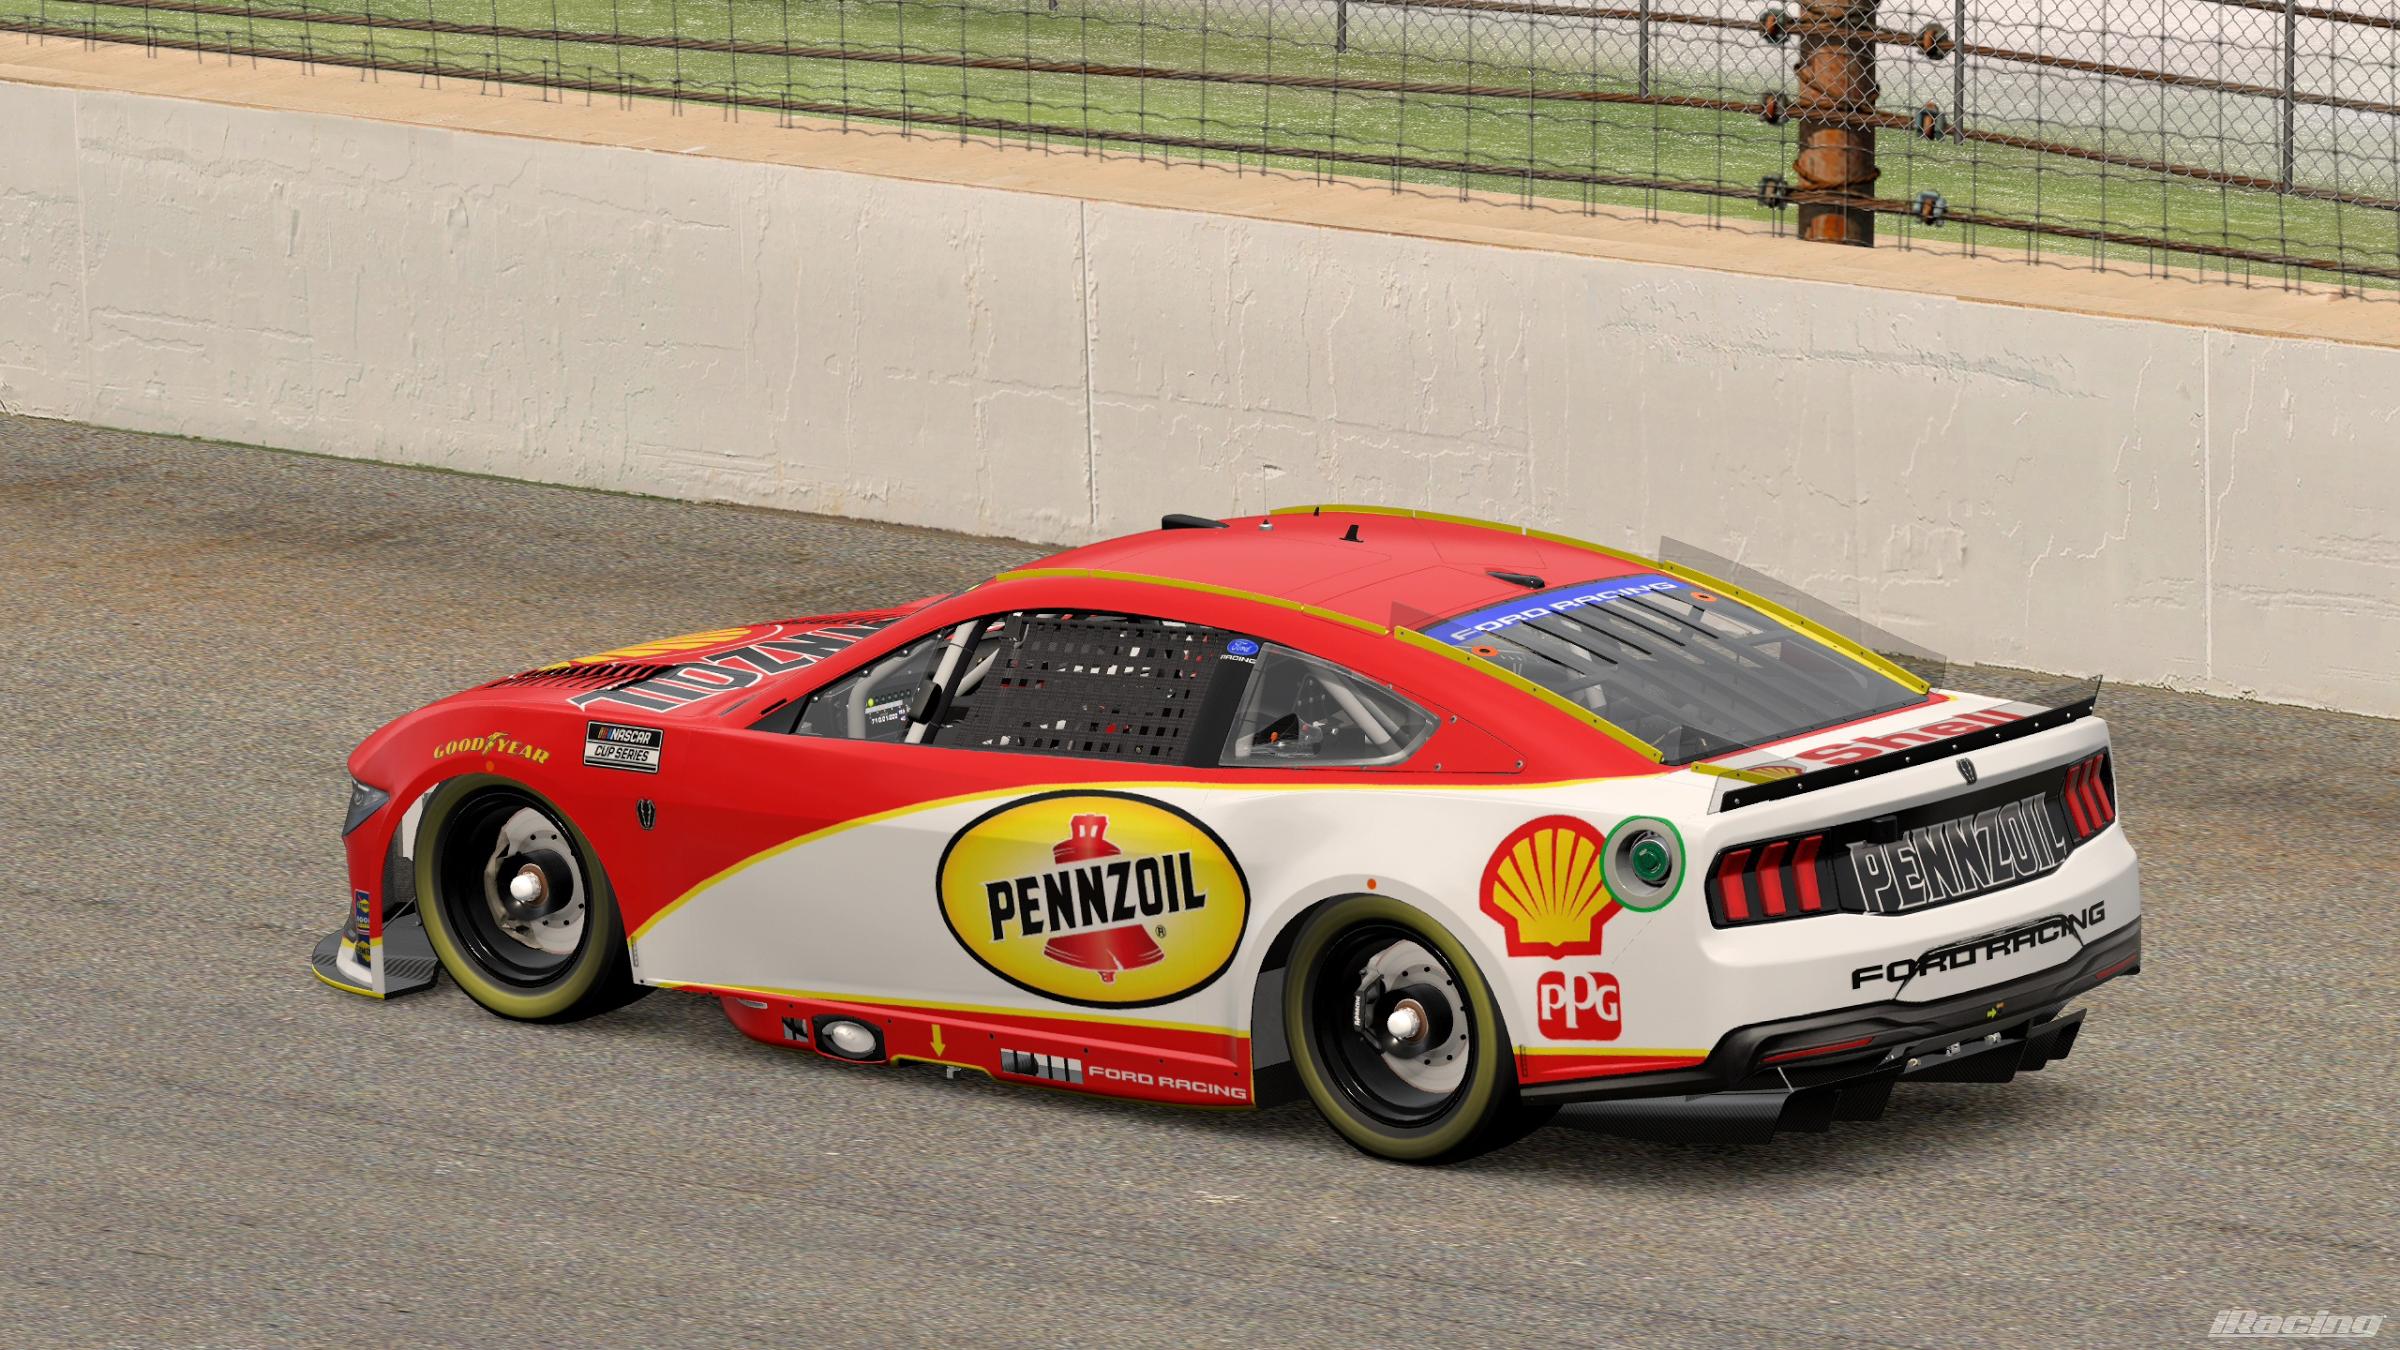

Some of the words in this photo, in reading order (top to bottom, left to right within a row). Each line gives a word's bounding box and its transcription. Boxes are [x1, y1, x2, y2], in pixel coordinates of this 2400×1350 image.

[1450, 607, 1551, 641] FORD
[1551, 581, 1679, 611] RACING
[433, 734, 550, 764] GOODYEAR
[594, 745, 616, 758] CUP
[615, 747, 649, 762] SERIES
[609, 728, 652, 745] NASCAR
[1794, 709, 2026, 766] Shell
[1846, 791, 2067, 915] PENNZOIL
[985, 851, 1207, 942] PENNZOIL
[1851, 947, 1977, 990] FORD
[1986, 900, 2106, 961] RACING
[1540, 970, 1619, 1029] PPG
[1088, 1065, 1154, 1086] FORD
[1158, 1076, 1247, 1100] RACING
